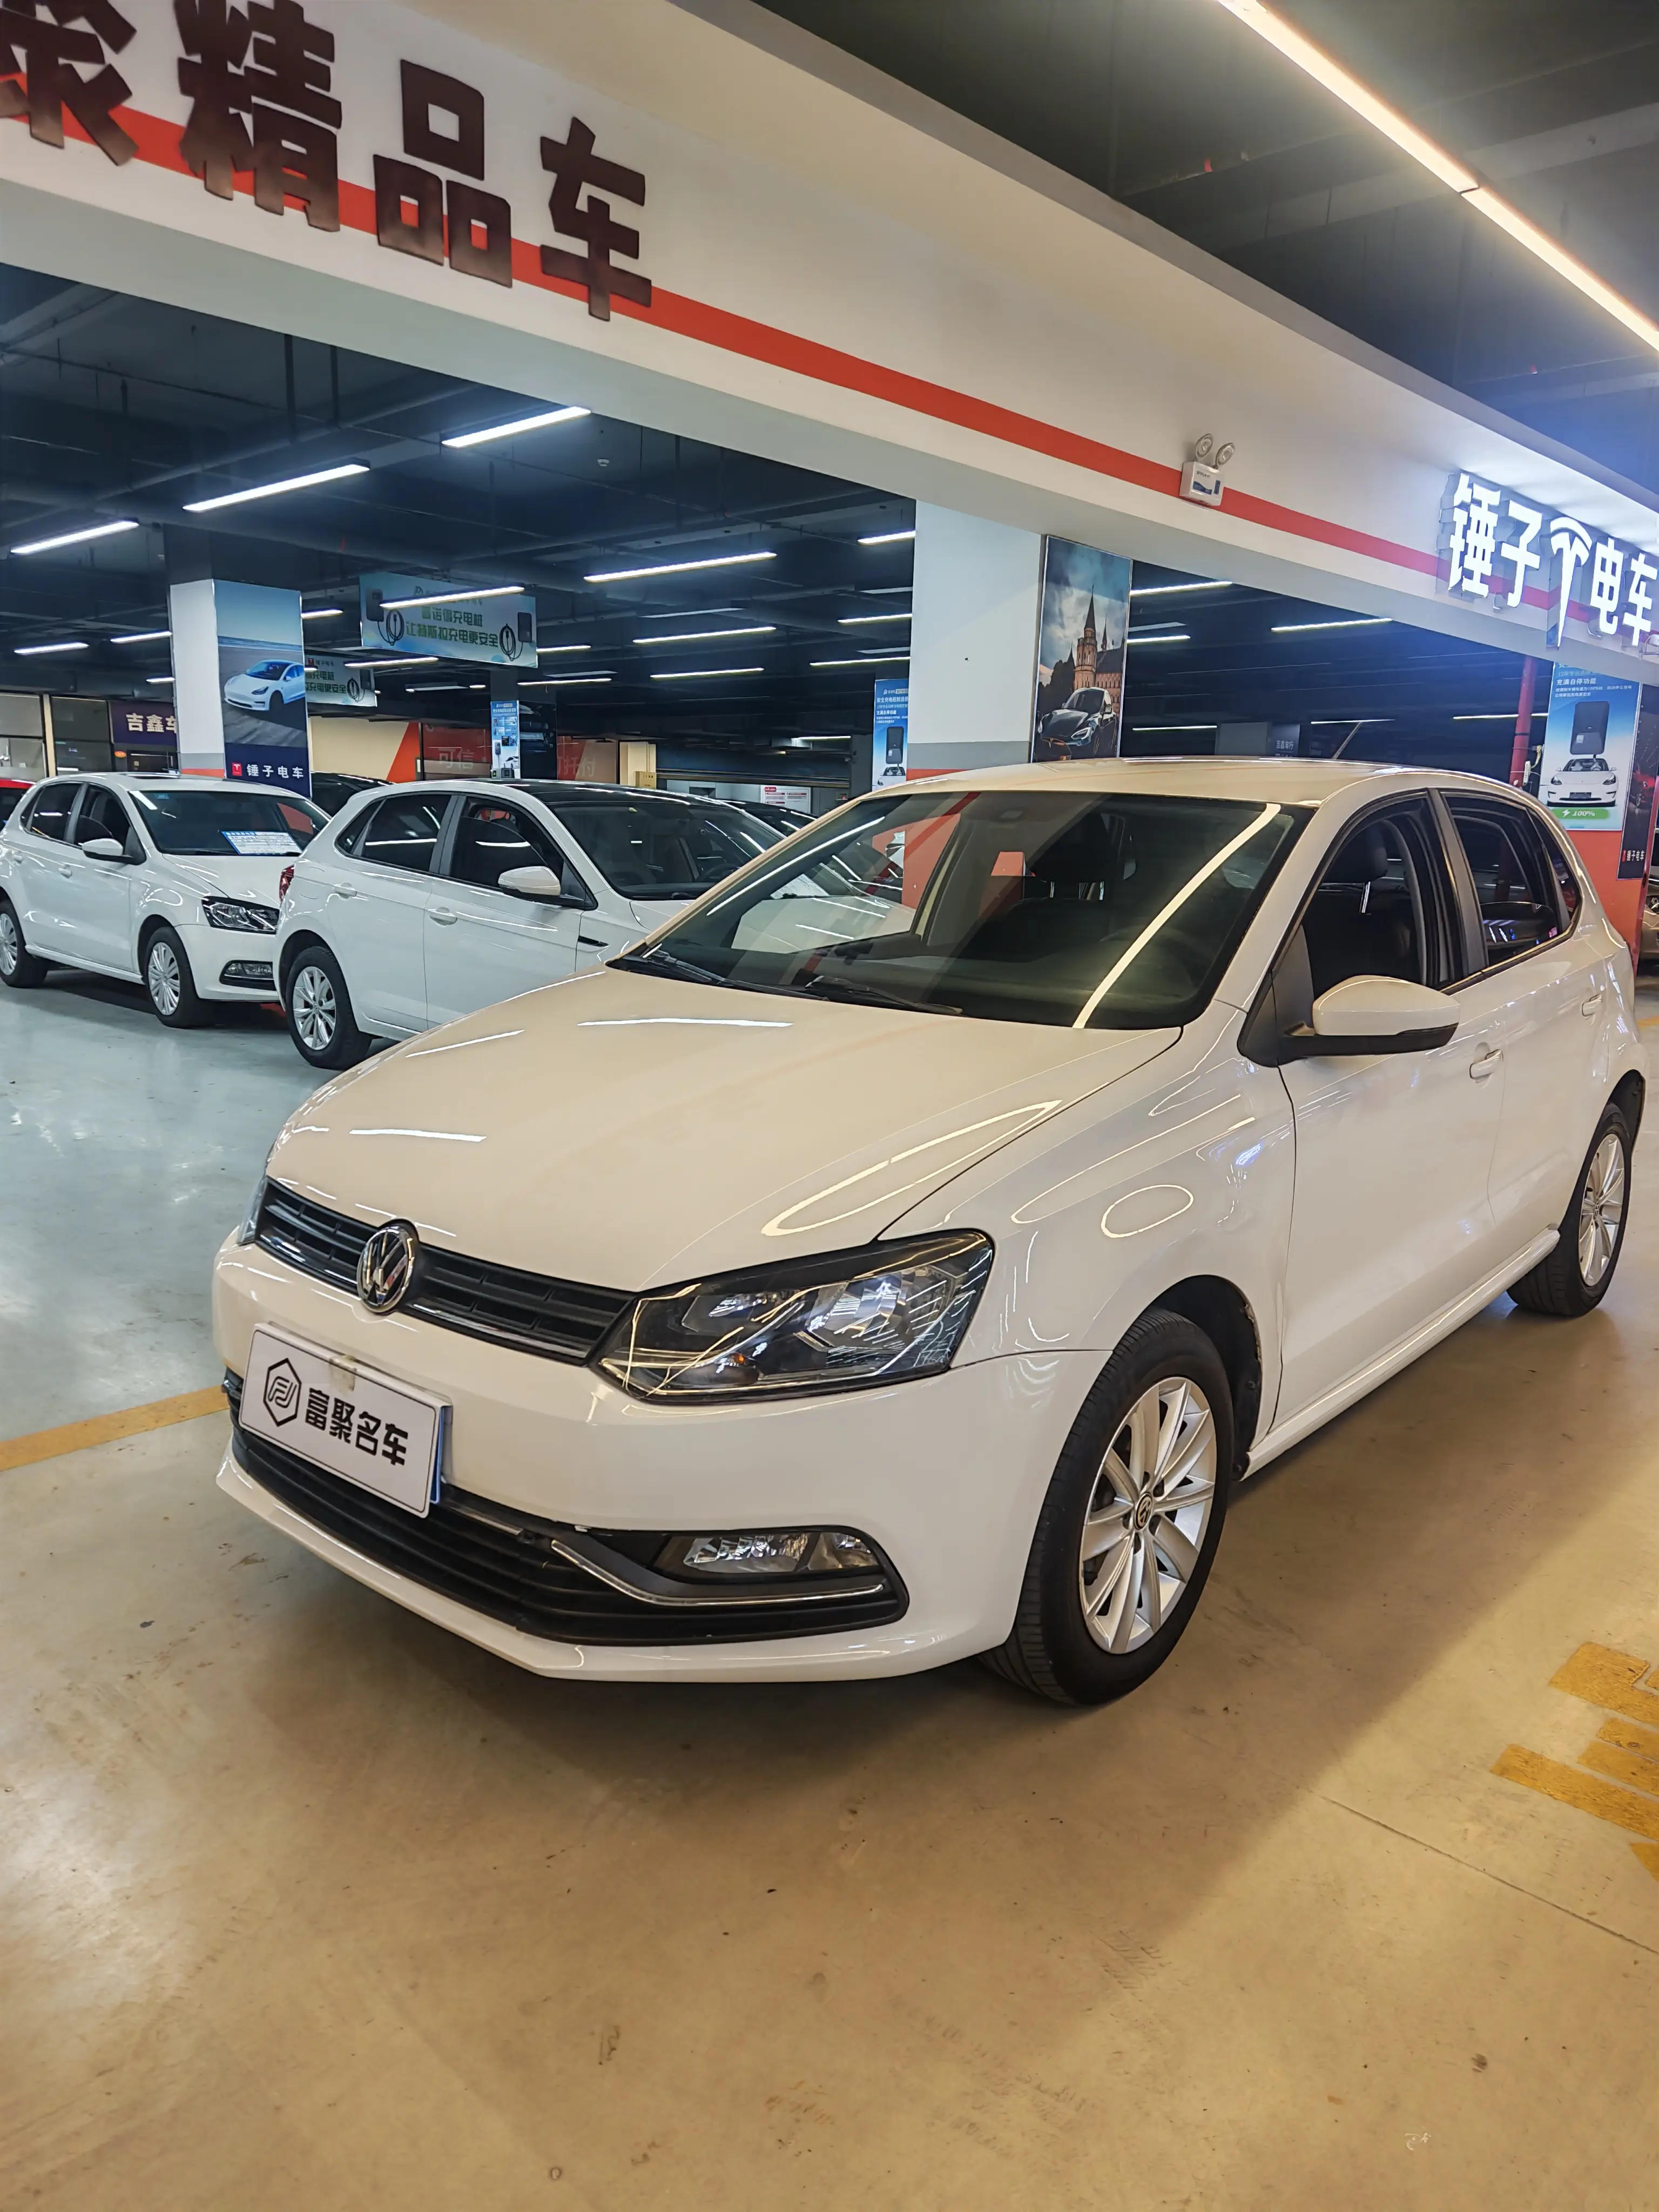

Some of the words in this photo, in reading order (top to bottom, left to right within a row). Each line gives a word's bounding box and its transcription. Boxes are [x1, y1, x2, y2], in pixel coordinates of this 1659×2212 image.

[406, 622, 498, 648] 让特斯拉充电更安全
[246, 764, 304, 779] 锤子电车
[1572, 808, 1596, 817] 100%
[305, 1387, 409, 1466] 富聚名车
